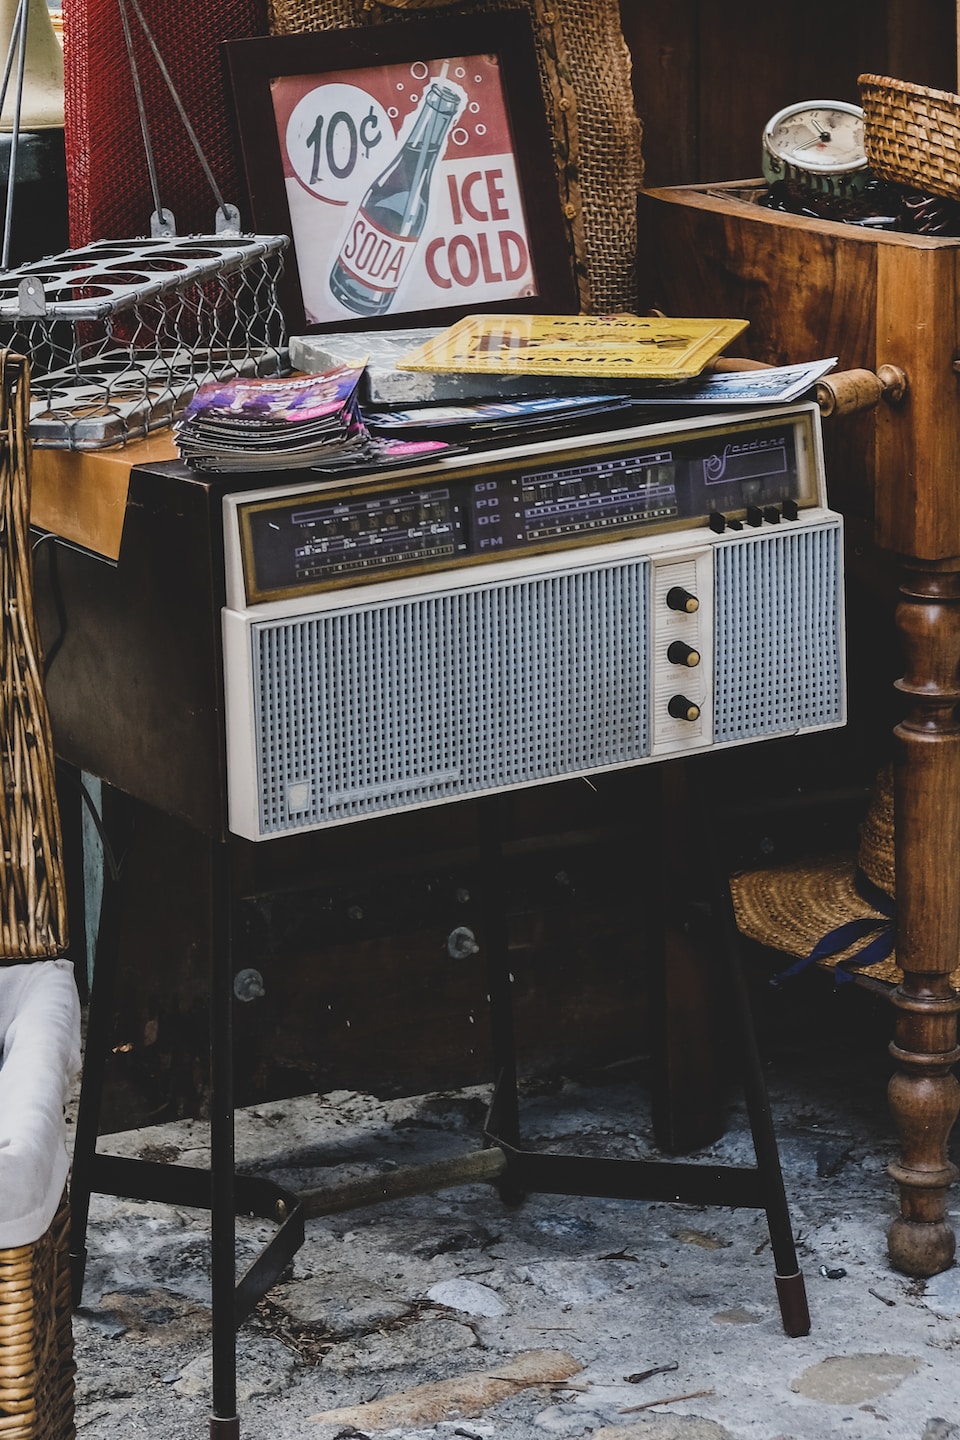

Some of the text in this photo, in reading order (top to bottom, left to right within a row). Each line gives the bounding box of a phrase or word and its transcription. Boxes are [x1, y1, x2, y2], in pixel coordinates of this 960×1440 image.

[306, 105, 383, 185] 10¢
[447, 168, 510, 226] ICE
[345, 220, 406, 283] SODA
[425, 230, 528, 290] COLD
[479, 536, 504, 549] FM
